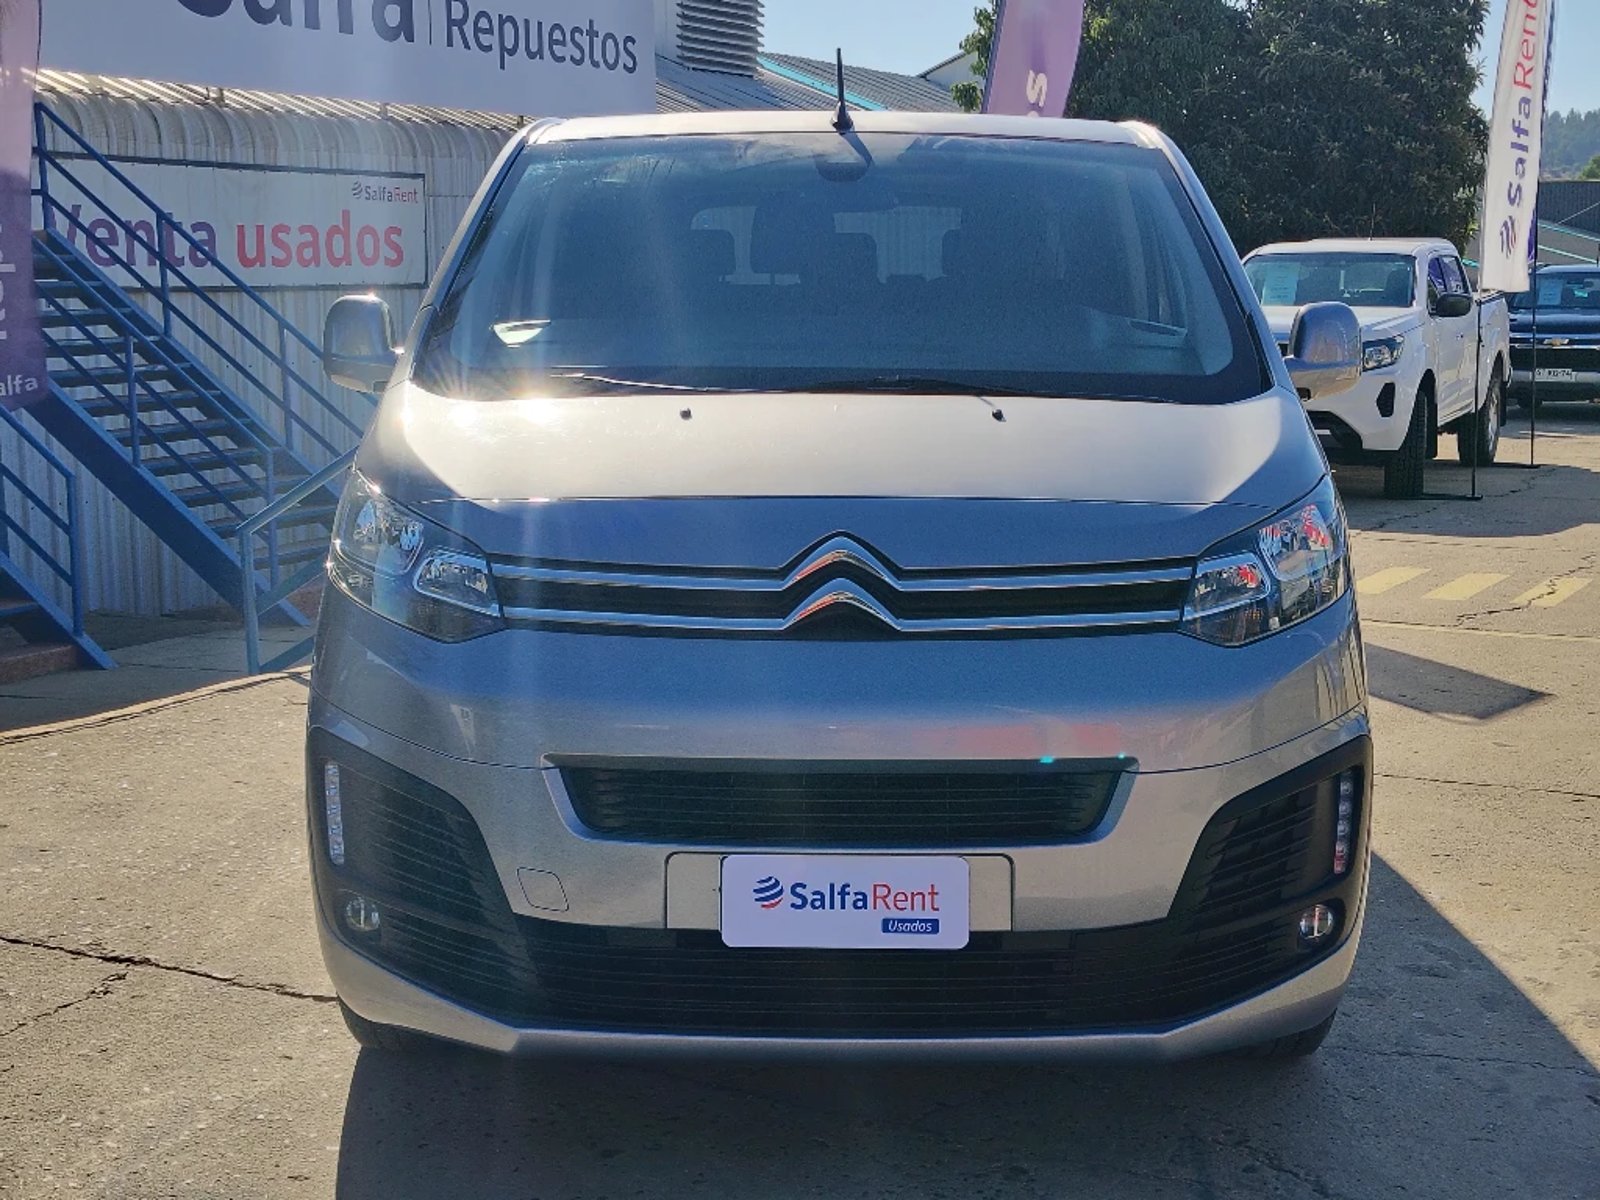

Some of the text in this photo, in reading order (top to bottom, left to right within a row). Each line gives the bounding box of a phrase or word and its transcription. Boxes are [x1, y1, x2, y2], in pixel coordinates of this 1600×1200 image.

[445, 0, 638, 74] Repuestos
[364, 185, 418, 203] SalfaRent
[236, 209, 405, 268] usados
[0, 374, 39, 396] alfa
[790, 882, 940, 912] SalfaRent
[888, 920, 933, 933] Usados
